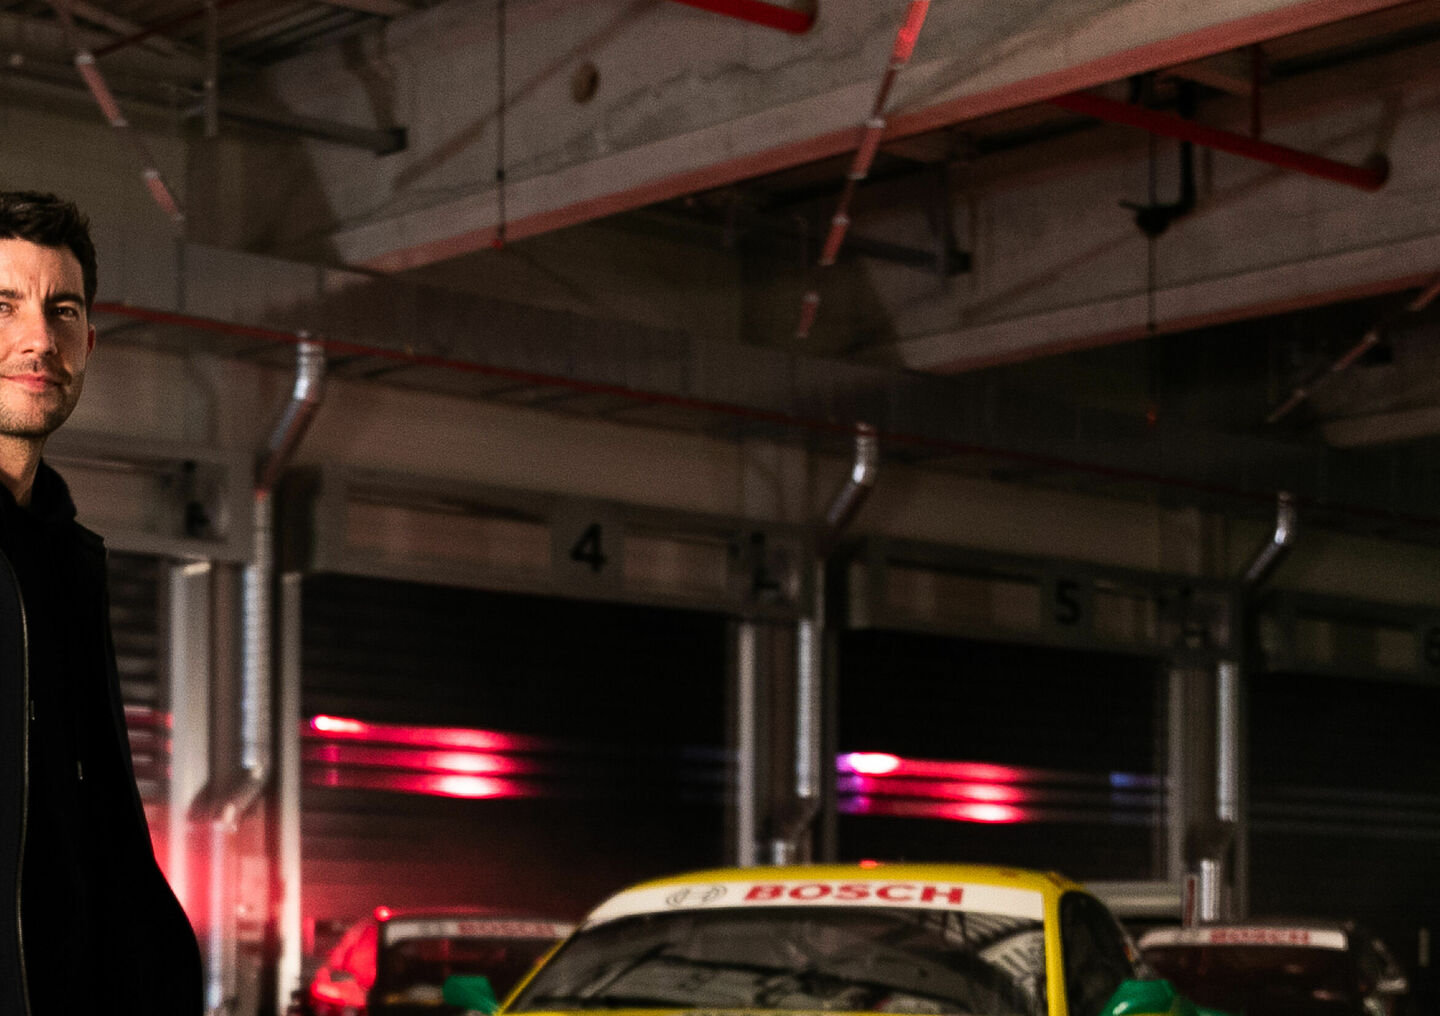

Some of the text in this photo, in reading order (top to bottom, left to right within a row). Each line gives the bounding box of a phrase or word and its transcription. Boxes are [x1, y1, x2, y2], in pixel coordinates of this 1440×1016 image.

[570, 523, 608, 571] 4
[1054, 579, 1080, 625] 5
[744, 883, 963, 905] BOSCH
